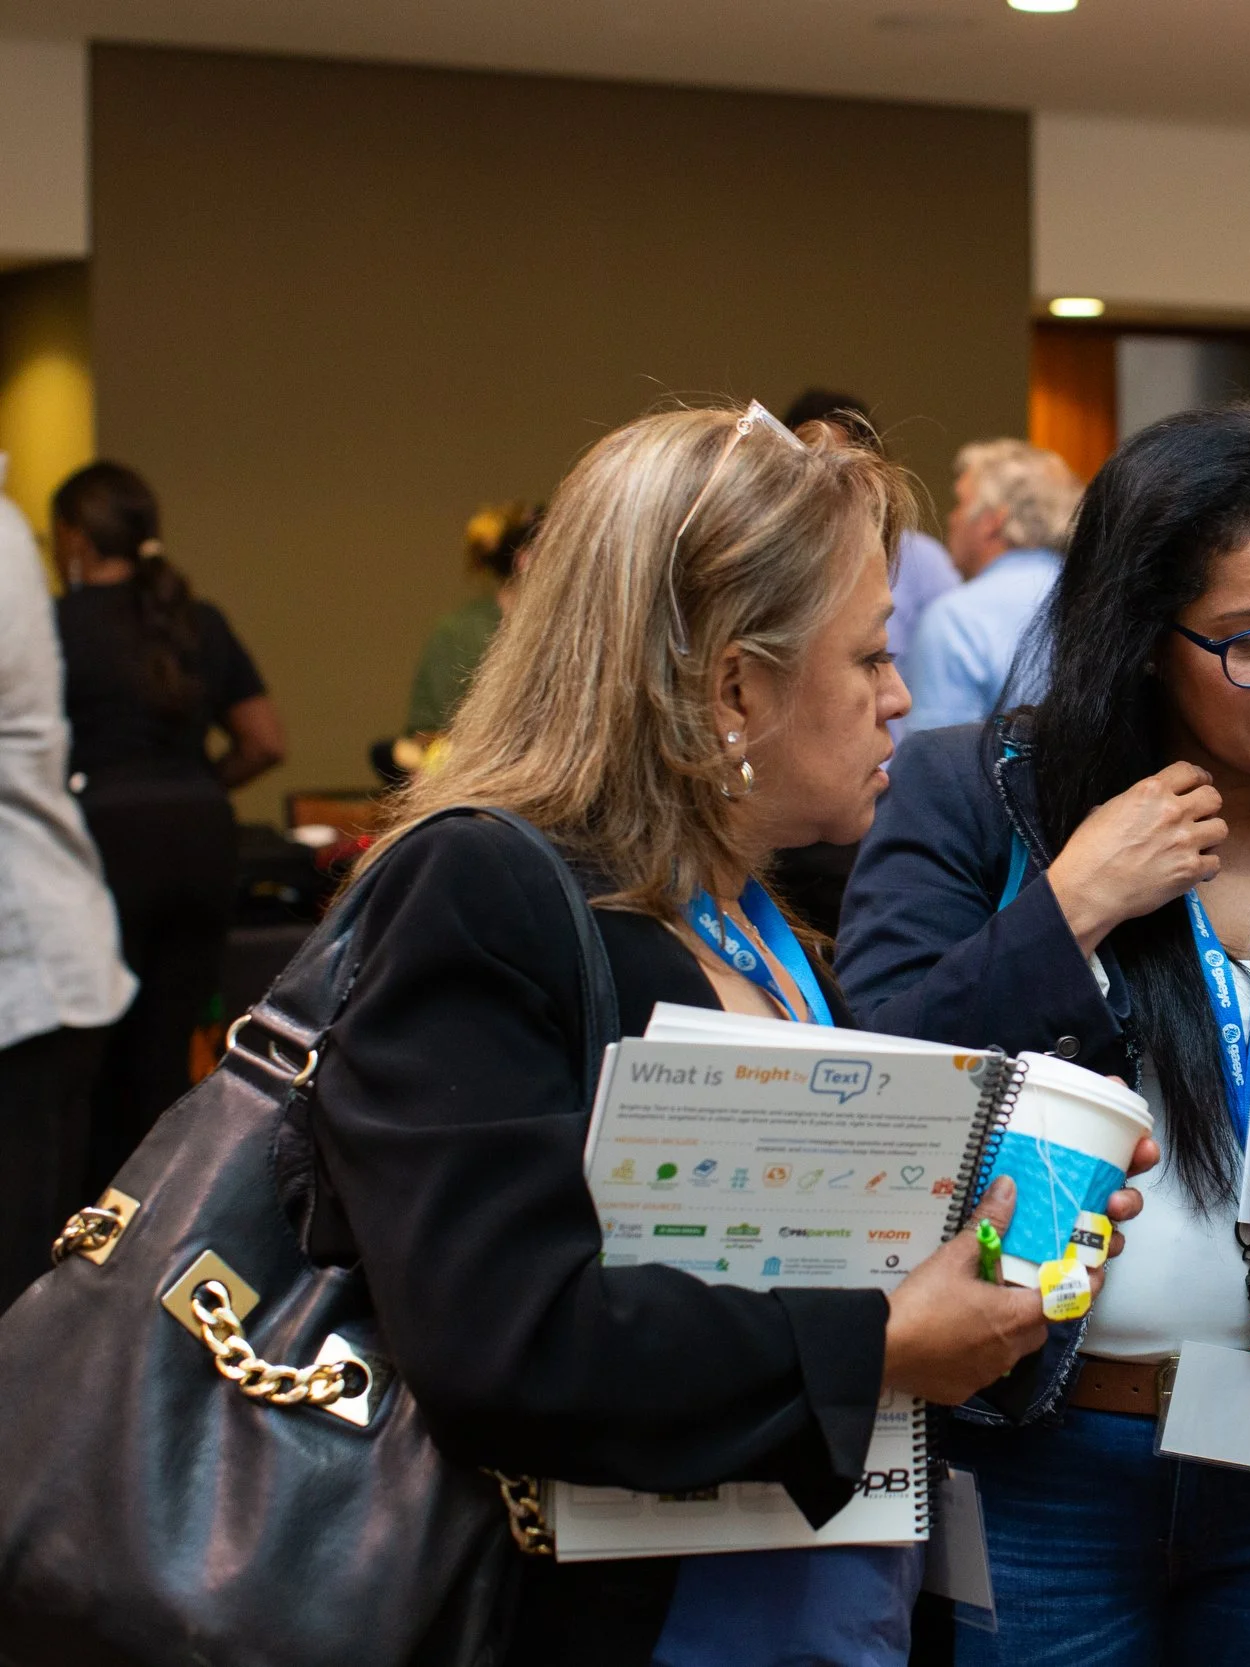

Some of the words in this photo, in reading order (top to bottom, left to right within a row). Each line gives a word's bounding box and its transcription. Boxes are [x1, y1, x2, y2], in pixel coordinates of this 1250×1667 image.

[1211, 966, 1232, 1008] gaeyc
[632, 1062, 696, 1085] What
[704, 1065, 724, 1086] is
[734, 1064, 792, 1084] Bright
[792, 1071, 808, 1084] by
[822, 1070, 860, 1084] Text
[877, 1073, 892, 1096] ?
[1228, 1043, 1244, 1086] gaeyc
